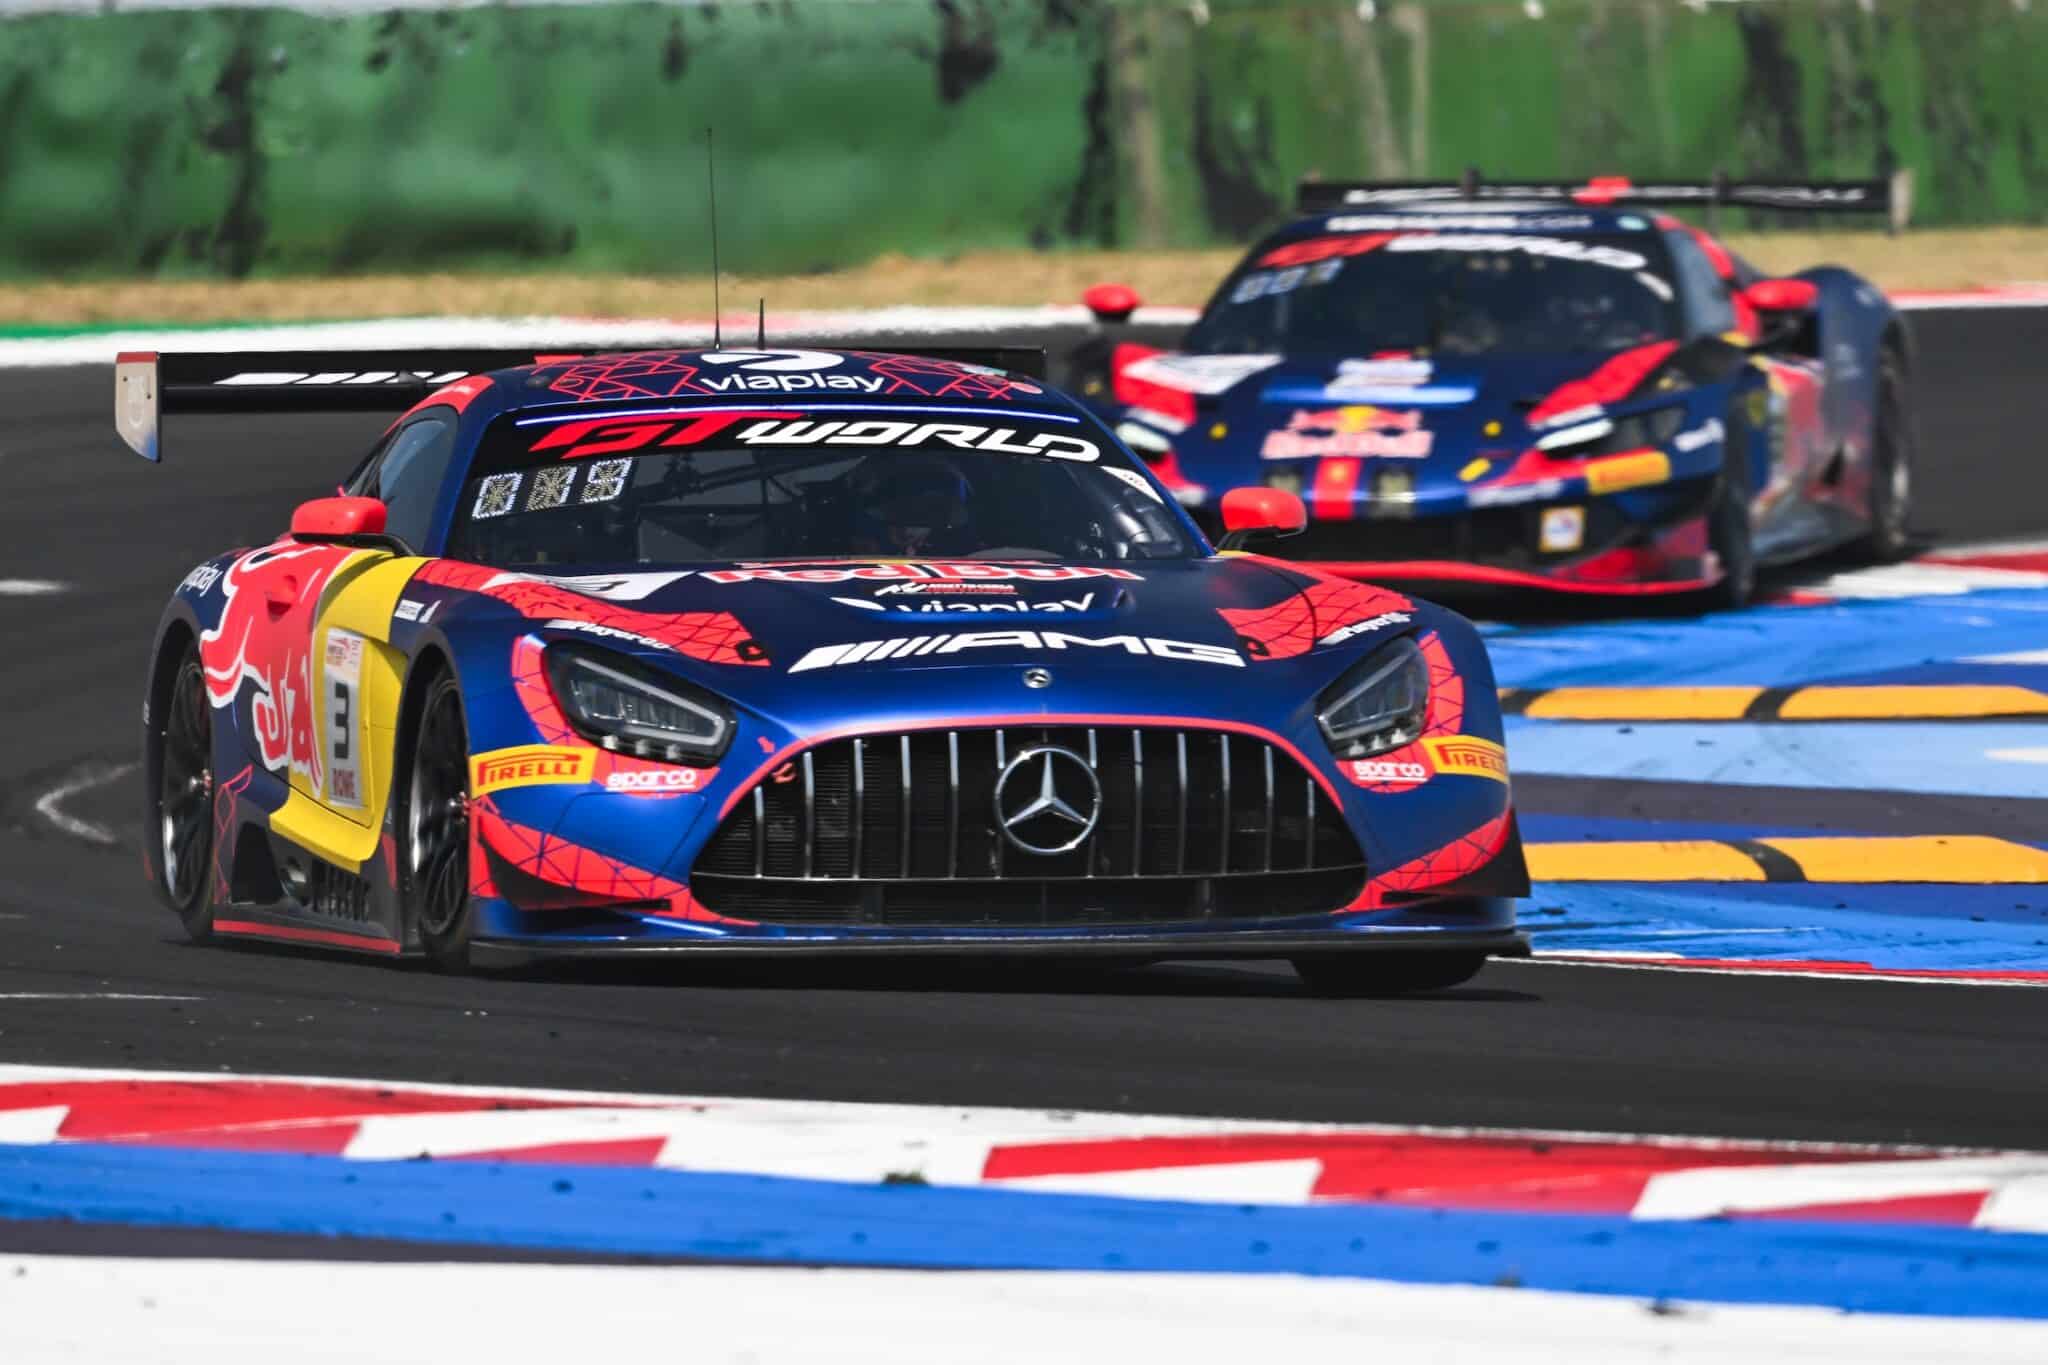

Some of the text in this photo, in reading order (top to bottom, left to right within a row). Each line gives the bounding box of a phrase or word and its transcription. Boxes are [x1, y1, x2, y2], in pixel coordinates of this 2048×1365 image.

[700, 372, 884, 393] viaplay
[528, 411, 1101, 462] GT WORLD
[934, 631, 1247, 667] AMG
[333, 681, 350, 760] 3
[477, 754, 582, 786] PIRELLI
[1352, 760, 1427, 782] sparco
[1436, 744, 1505, 773] PIREL
[606, 768, 696, 791] sparco
